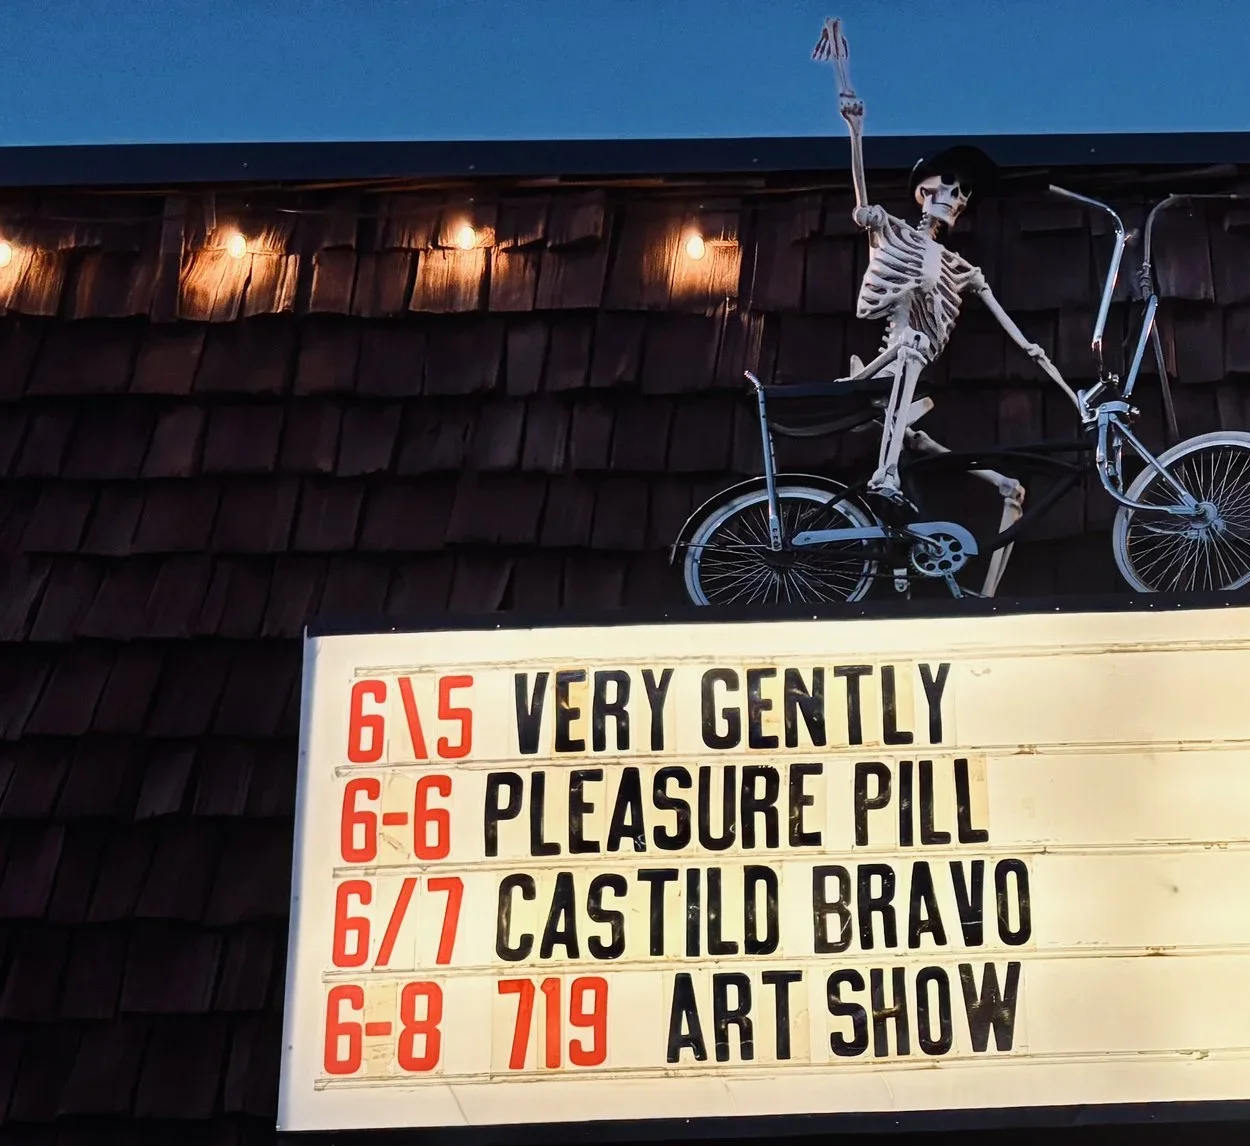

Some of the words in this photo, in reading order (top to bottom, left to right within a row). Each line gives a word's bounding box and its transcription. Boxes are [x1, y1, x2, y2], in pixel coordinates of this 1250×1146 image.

[514, 667, 675, 752] VERY
[701, 662, 950, 748] GENTLY
[339, 774, 452, 863] 6-6
[483, 762, 824, 857] PLEASURE
[854, 757, 990, 848] PILL
[332, 876, 465, 968] 6/7
[812, 857, 1031, 953] BRAVO
[323, 981, 444, 1075] 6-8
[497, 975, 609, 1070] 719
[666, 968, 803, 1064] ART
[828, 961, 1022, 1058] SHOW
